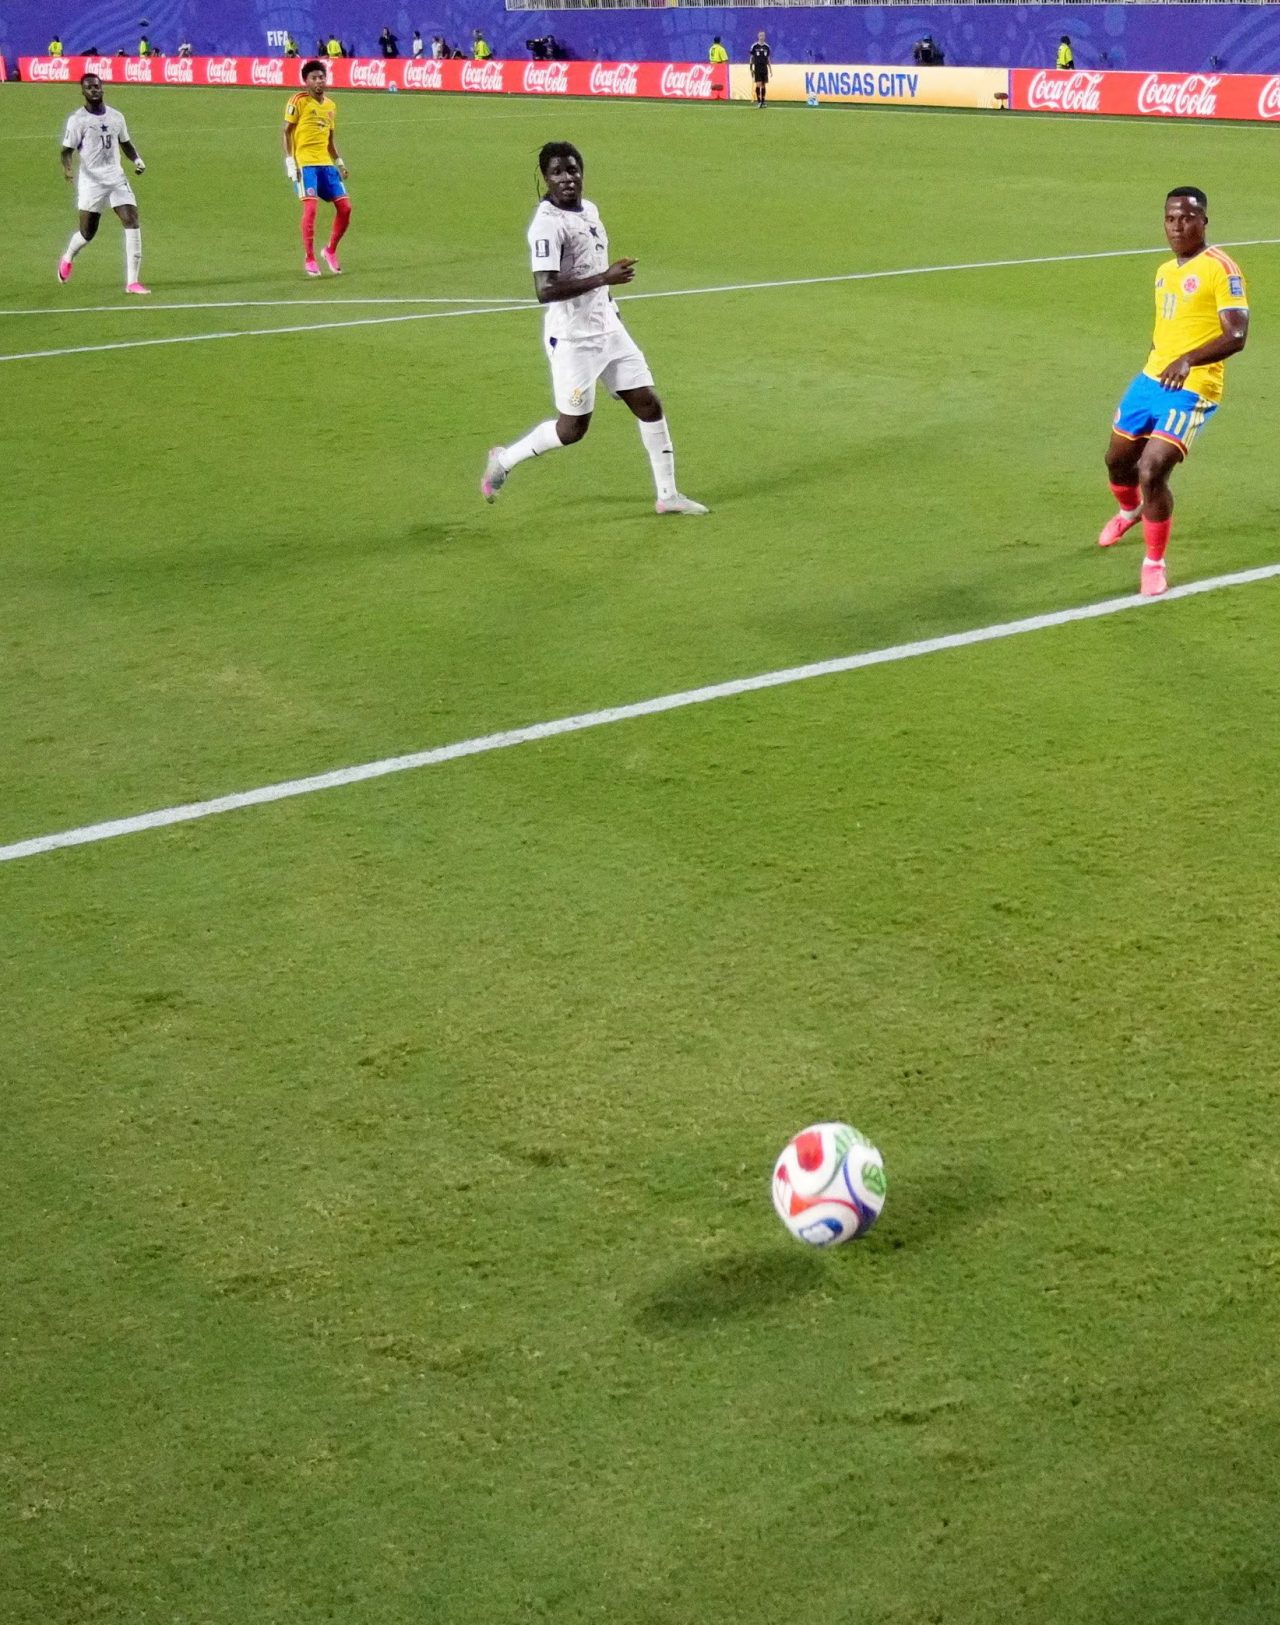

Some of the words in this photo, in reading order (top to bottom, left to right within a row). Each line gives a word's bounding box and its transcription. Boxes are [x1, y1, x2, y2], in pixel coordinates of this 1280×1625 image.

[267, 30, 289, 47] FIFA
[349, 59, 386, 88] Coca-Cola
[403, 60, 443, 89] Coca-Cola
[461, 60, 504, 91] Coca-Cola
[522, 61, 569, 93] Coca-Cola
[589, 62, 639, 95] Coca-Cola
[660, 62, 715, 98] Coca-Cola
[805, 72, 875, 96] KANSAS
[878, 73, 919, 97] CITY
[1027, 70, 1105, 111] Coca-Cola
[1138, 73, 1222, 116] Coca-Cola
[1162, 293, 1178, 320] 11
[1164, 408, 1187, 435] 11
